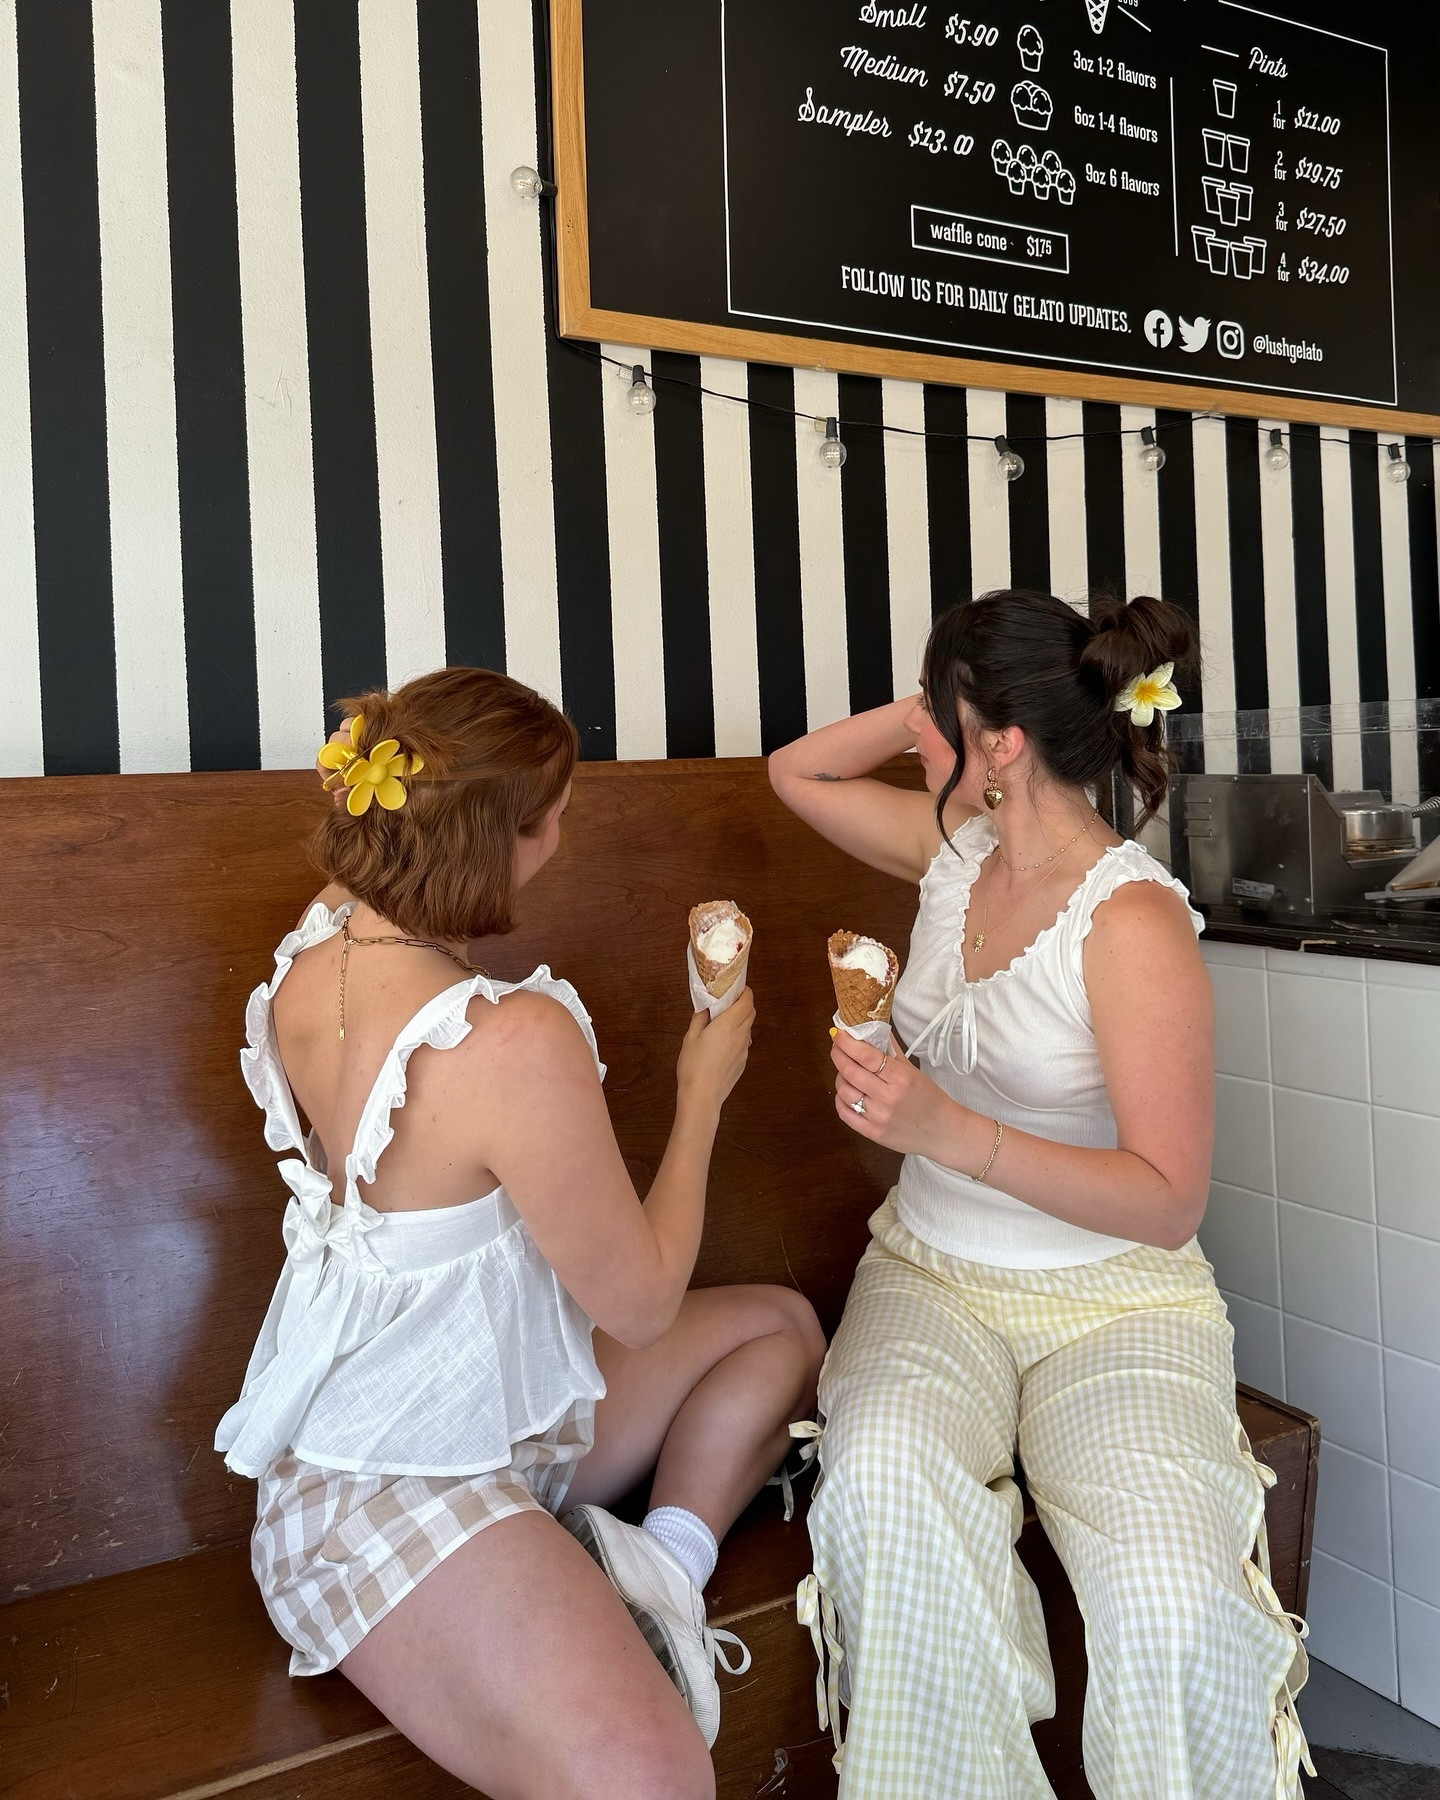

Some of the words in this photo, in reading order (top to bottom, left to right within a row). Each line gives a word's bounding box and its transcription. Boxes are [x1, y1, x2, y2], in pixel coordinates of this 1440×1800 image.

[859, 0, 927, 28] Small
[945, 14, 999, 46] $5.90
[840, 46, 928, 87] Medium
[944, 71, 995, 104] $7.50
[1074, 50, 1094, 72] 3oz
[1098, 57, 1114, 78] 1-2
[1118, 62, 1156, 89] flavors
[1249, 47, 1288, 78] Pints
[798, 87, 892, 137] Sampler
[1273, 113, 1286, 129] for
[1276, 100, 1282, 115] 1
[1294, 107, 1340, 135] $11.00
[1075, 106, 1095, 128] 6oz
[1099, 112, 1115, 132] 1-4
[1119, 117, 1158, 143] flavors
[1274, 164, 1287, 181] for
[1277, 151, 1283, 166] 2
[1086, 163, 1106, 185] 9oz
[1110, 169, 1117, 187] 6
[1121, 171, 1159, 196] flavors
[1296, 157, 1343, 189] $19.75
[1278, 201, 1284, 217] 3
[1297, 207, 1346, 237] $27.50
[930, 222, 972, 244] waffle
[977, 233, 1007, 250] cone
[1275, 215, 1288, 232] for
[1280, 252, 1286, 267] 4
[1298, 256, 1349, 284] $34.00
[1277, 266, 1290, 282] for
[841, 266, 904, 297] FOLLOW
[911, 278, 931, 302] US
[936, 282, 964, 307] FOR
[969, 287, 1008, 314] DAILY
[1014, 295, 1064, 322] GELATO
[1069, 304, 1131, 333] UPDATES.
[1253, 335, 1322, 363] @lushgelato
